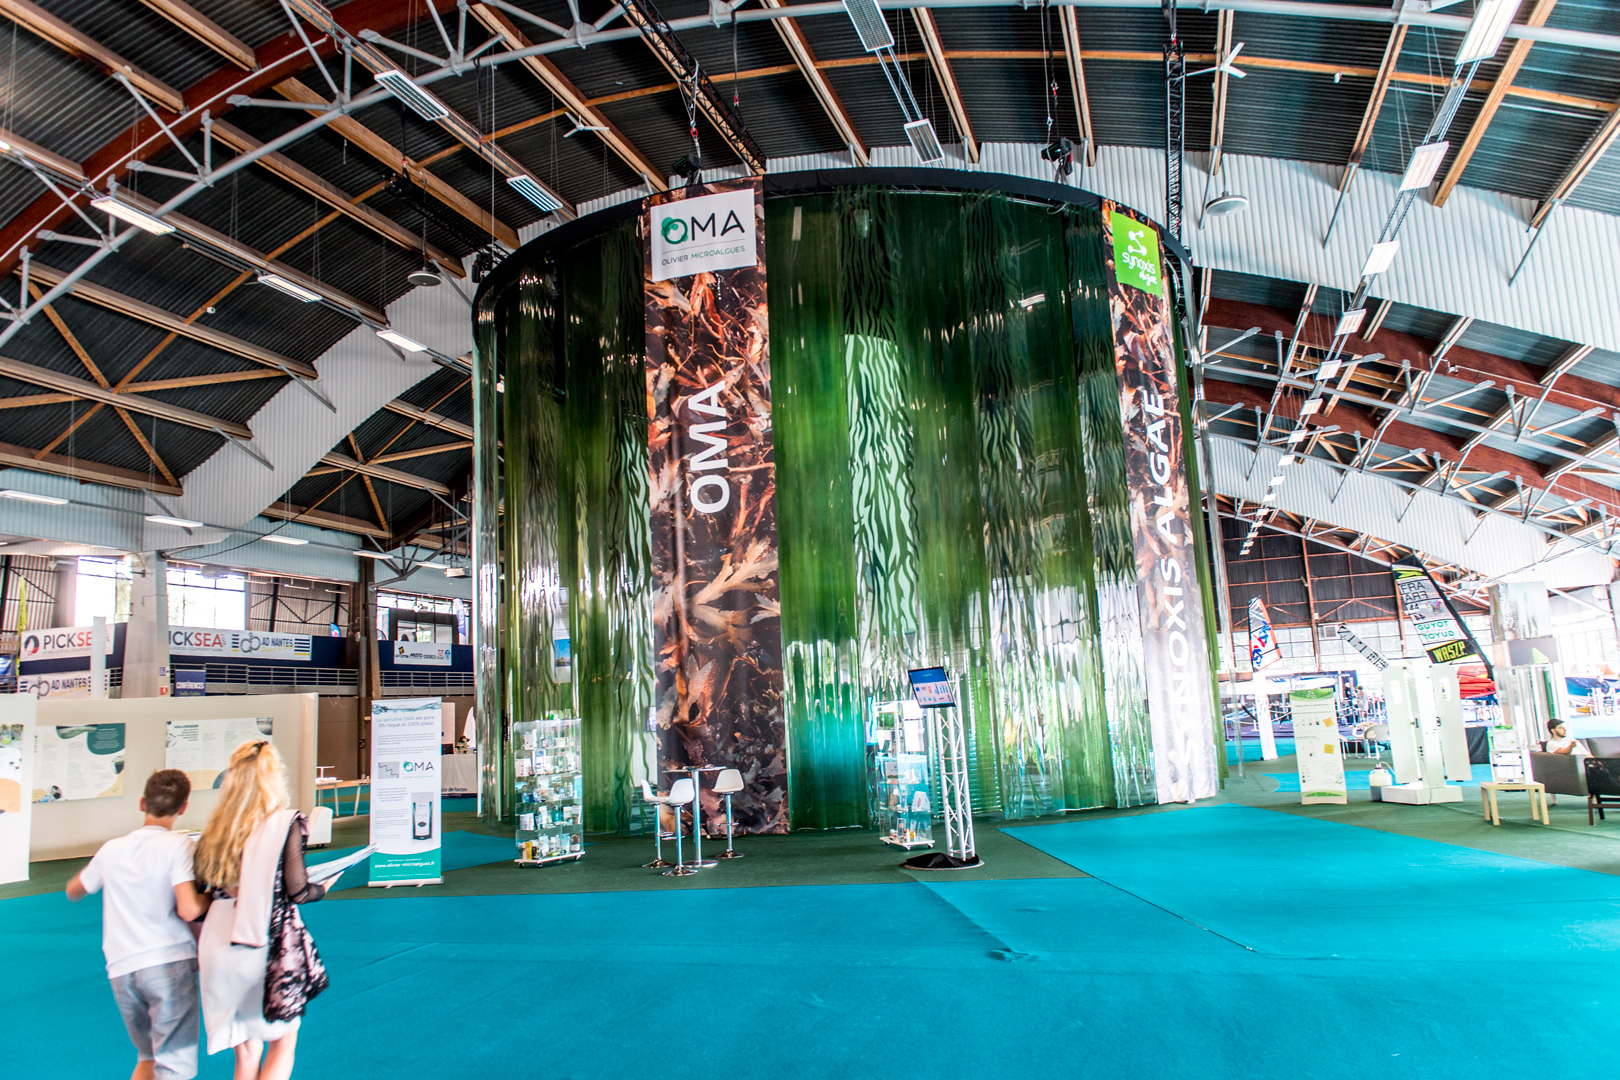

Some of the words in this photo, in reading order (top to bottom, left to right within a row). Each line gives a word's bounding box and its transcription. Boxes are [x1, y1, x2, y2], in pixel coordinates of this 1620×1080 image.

[661, 209, 745, 245] OMA
[661, 254, 689, 266] OLIVIER
[690, 245, 745, 260] MICROALGUES
[687, 380, 730, 514] OMA
[1142, 389, 1178, 545] ALGAE
[1400, 581, 1426, 594] FRA
[1417, 620, 1449, 631] GUYOT
[43, 631, 93, 649] PICKSE
[168, 630, 224, 648] ICKSEA
[261, 636, 270, 647] AD
[271, 637, 293, 648] NANTES
[1160, 557, 1199, 766] SYNOXIS
[51, 679, 60, 690] AD
[61, 677, 87, 689] NANTES
[403, 761, 435, 772] OMA
